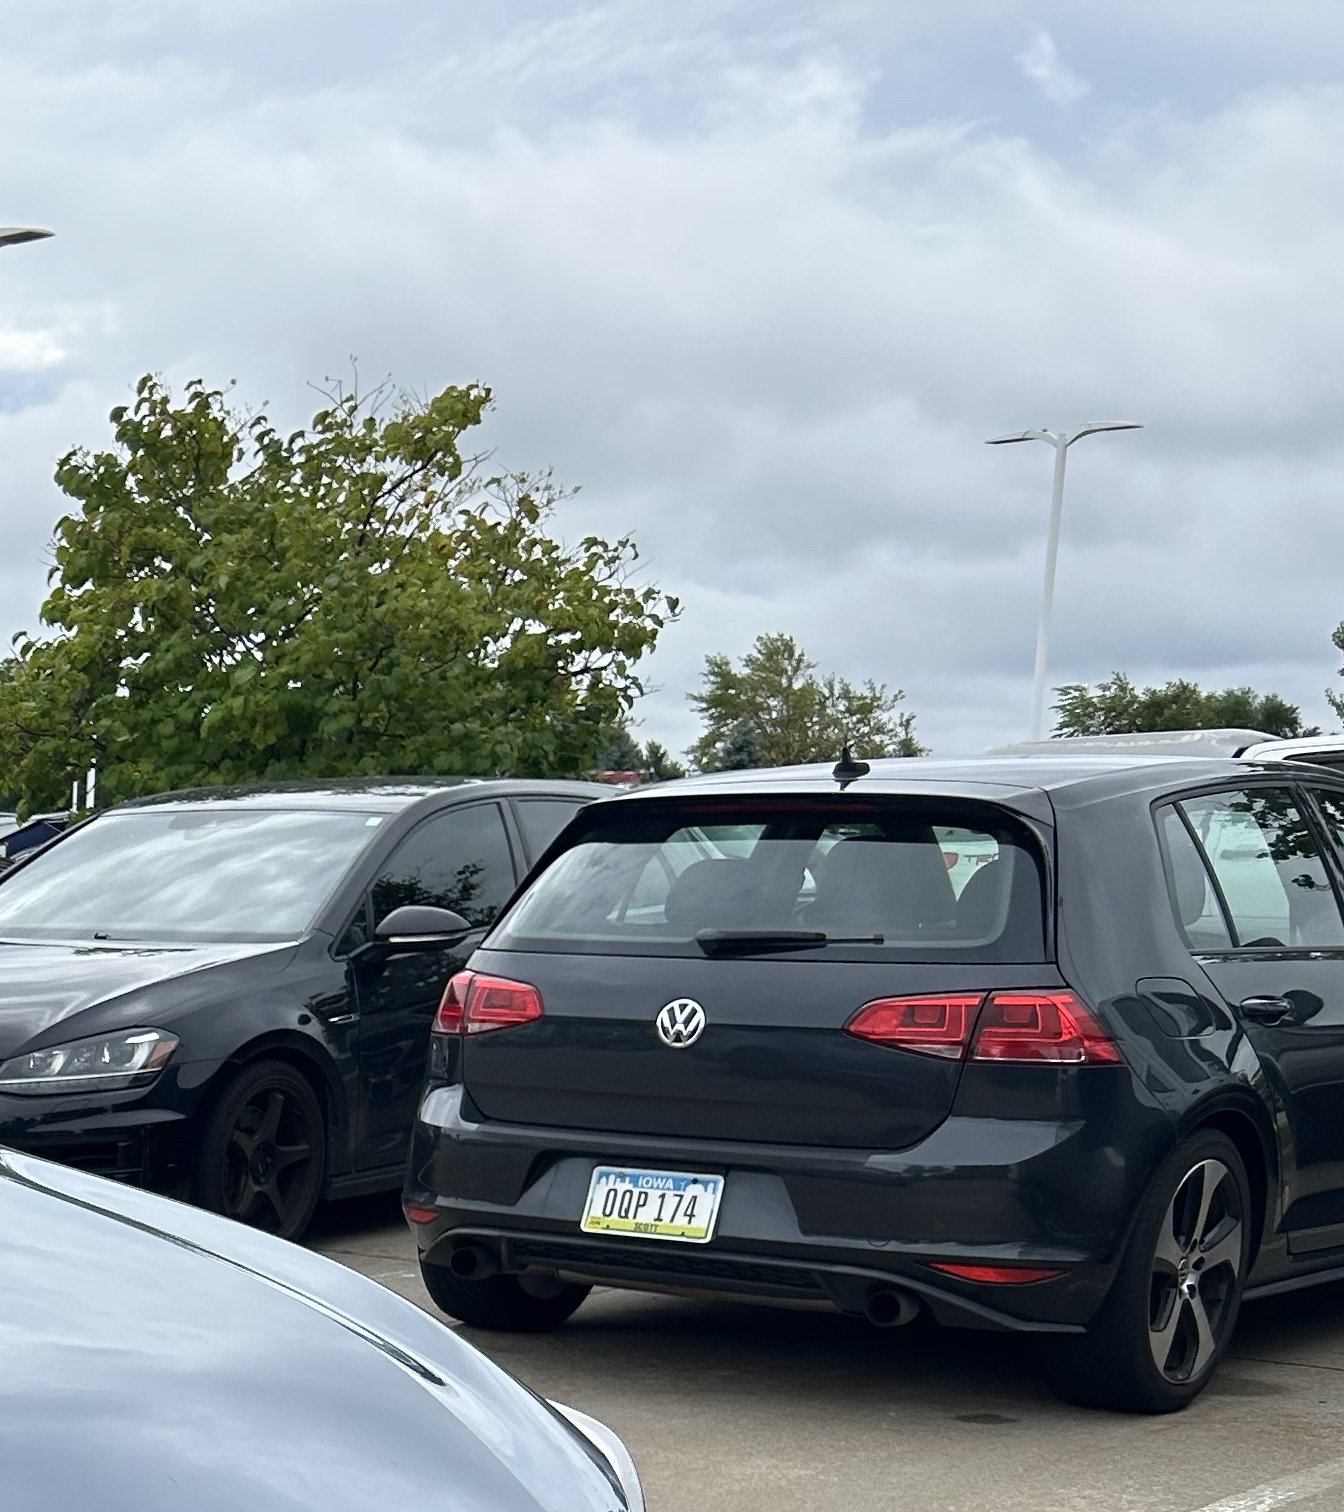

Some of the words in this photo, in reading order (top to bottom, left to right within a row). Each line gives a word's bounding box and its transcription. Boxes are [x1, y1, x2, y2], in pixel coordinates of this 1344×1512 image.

[638, 1175, 674, 1189] IOWA
[653, 1192, 699, 1225] 174
[633, 1222, 660, 1232] SCOTT
